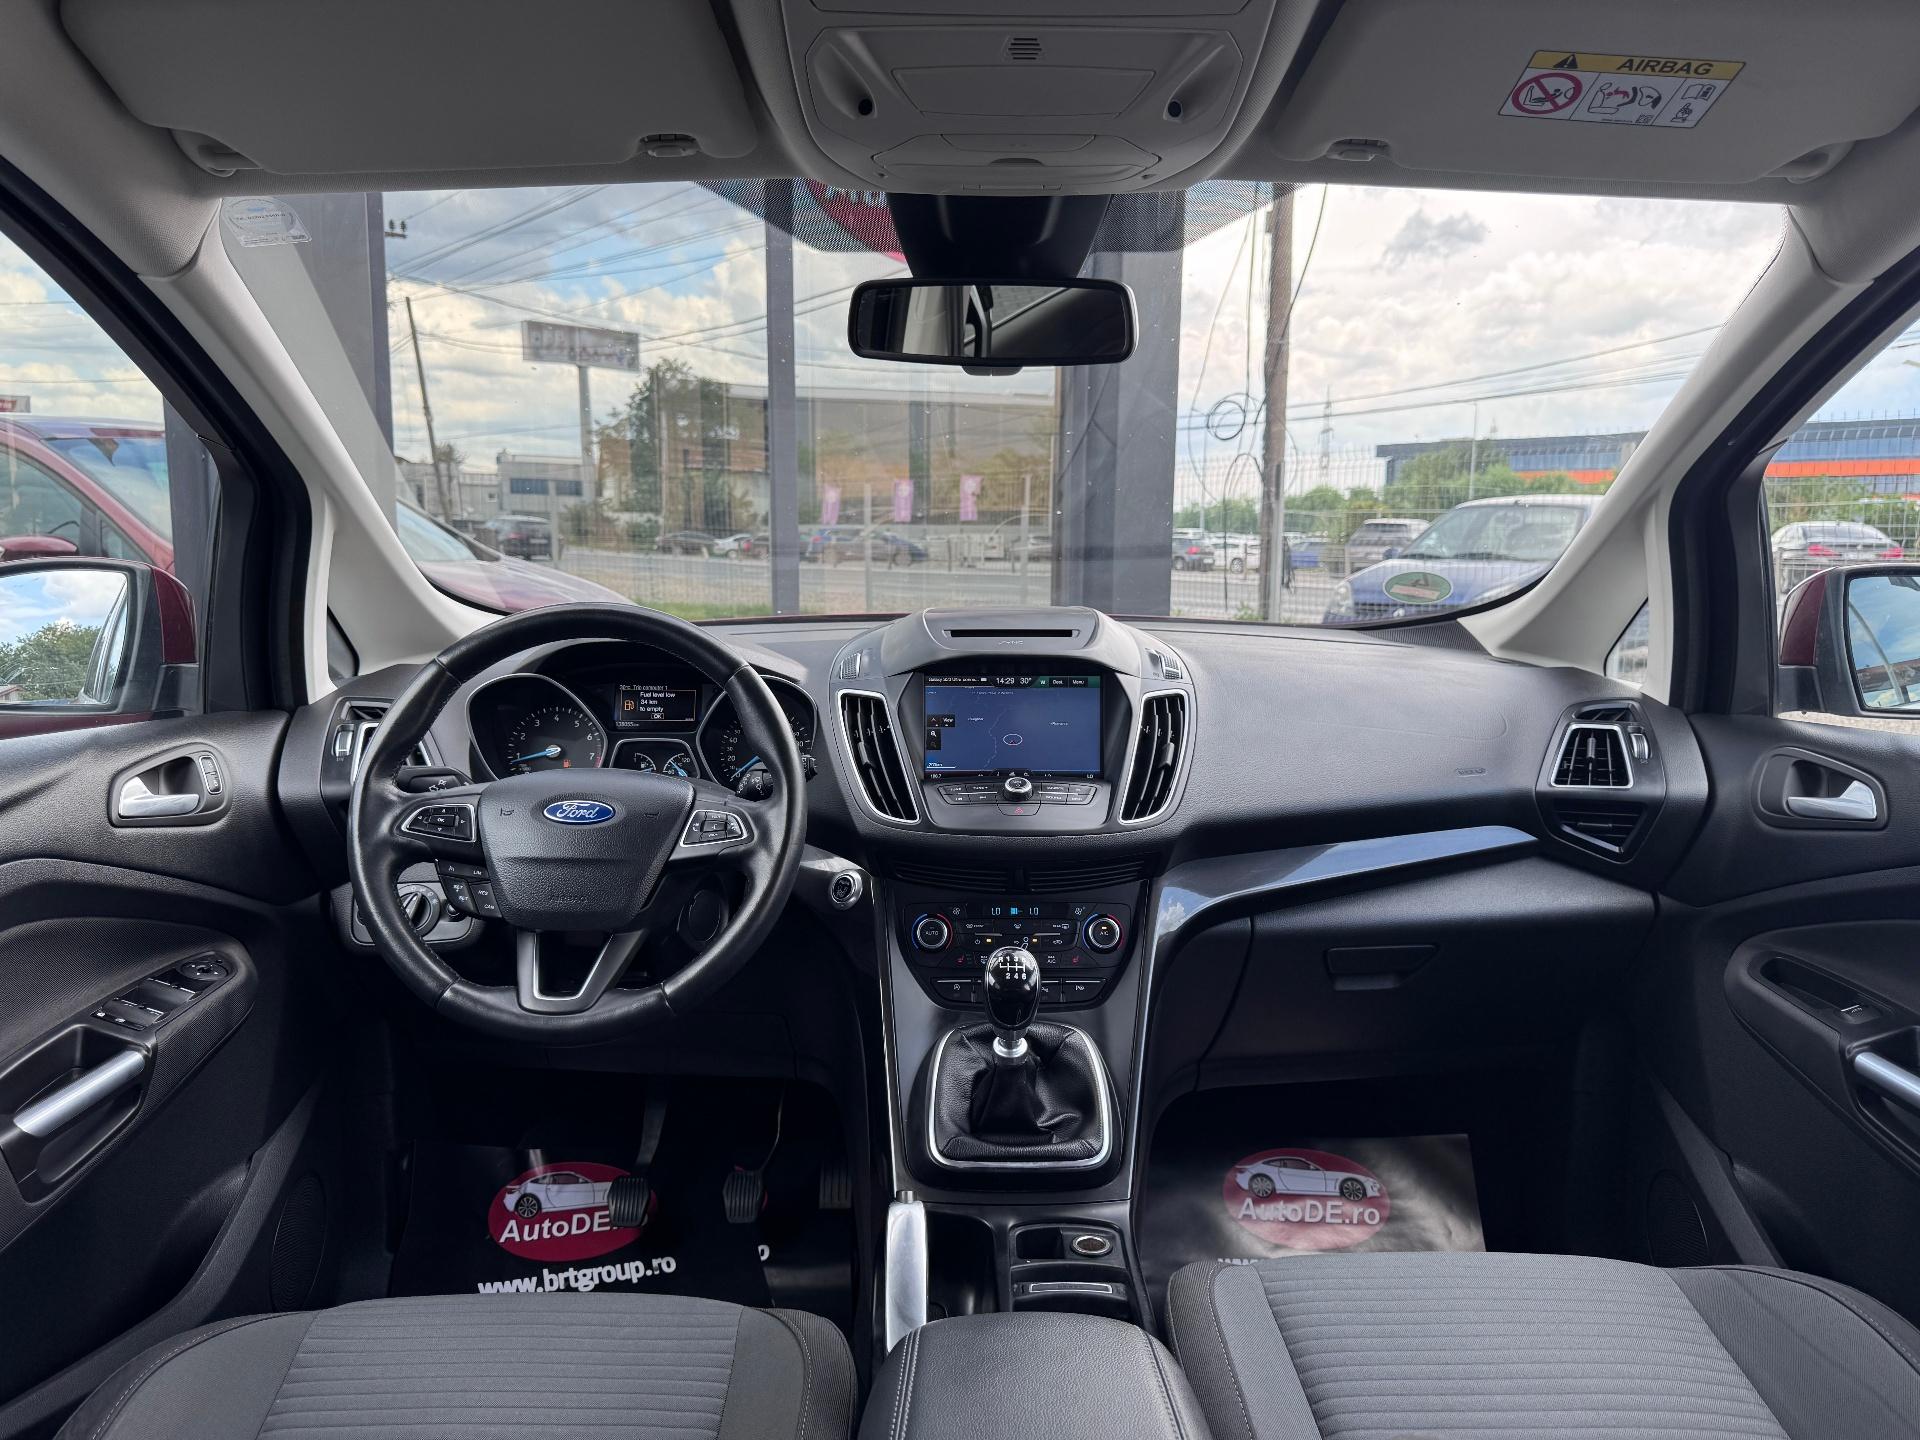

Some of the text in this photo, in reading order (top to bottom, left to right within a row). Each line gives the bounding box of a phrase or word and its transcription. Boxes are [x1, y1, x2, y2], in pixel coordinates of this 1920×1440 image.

[1616, 58, 1714, 76] AIRBAG
[557, 802, 600, 818] Ford
[1237, 1197, 1380, 1225] AutoDE.ro
[498, 1210, 648, 1243] AutoDE.
[477, 1256, 677, 1294] www.brtgroup.ro
